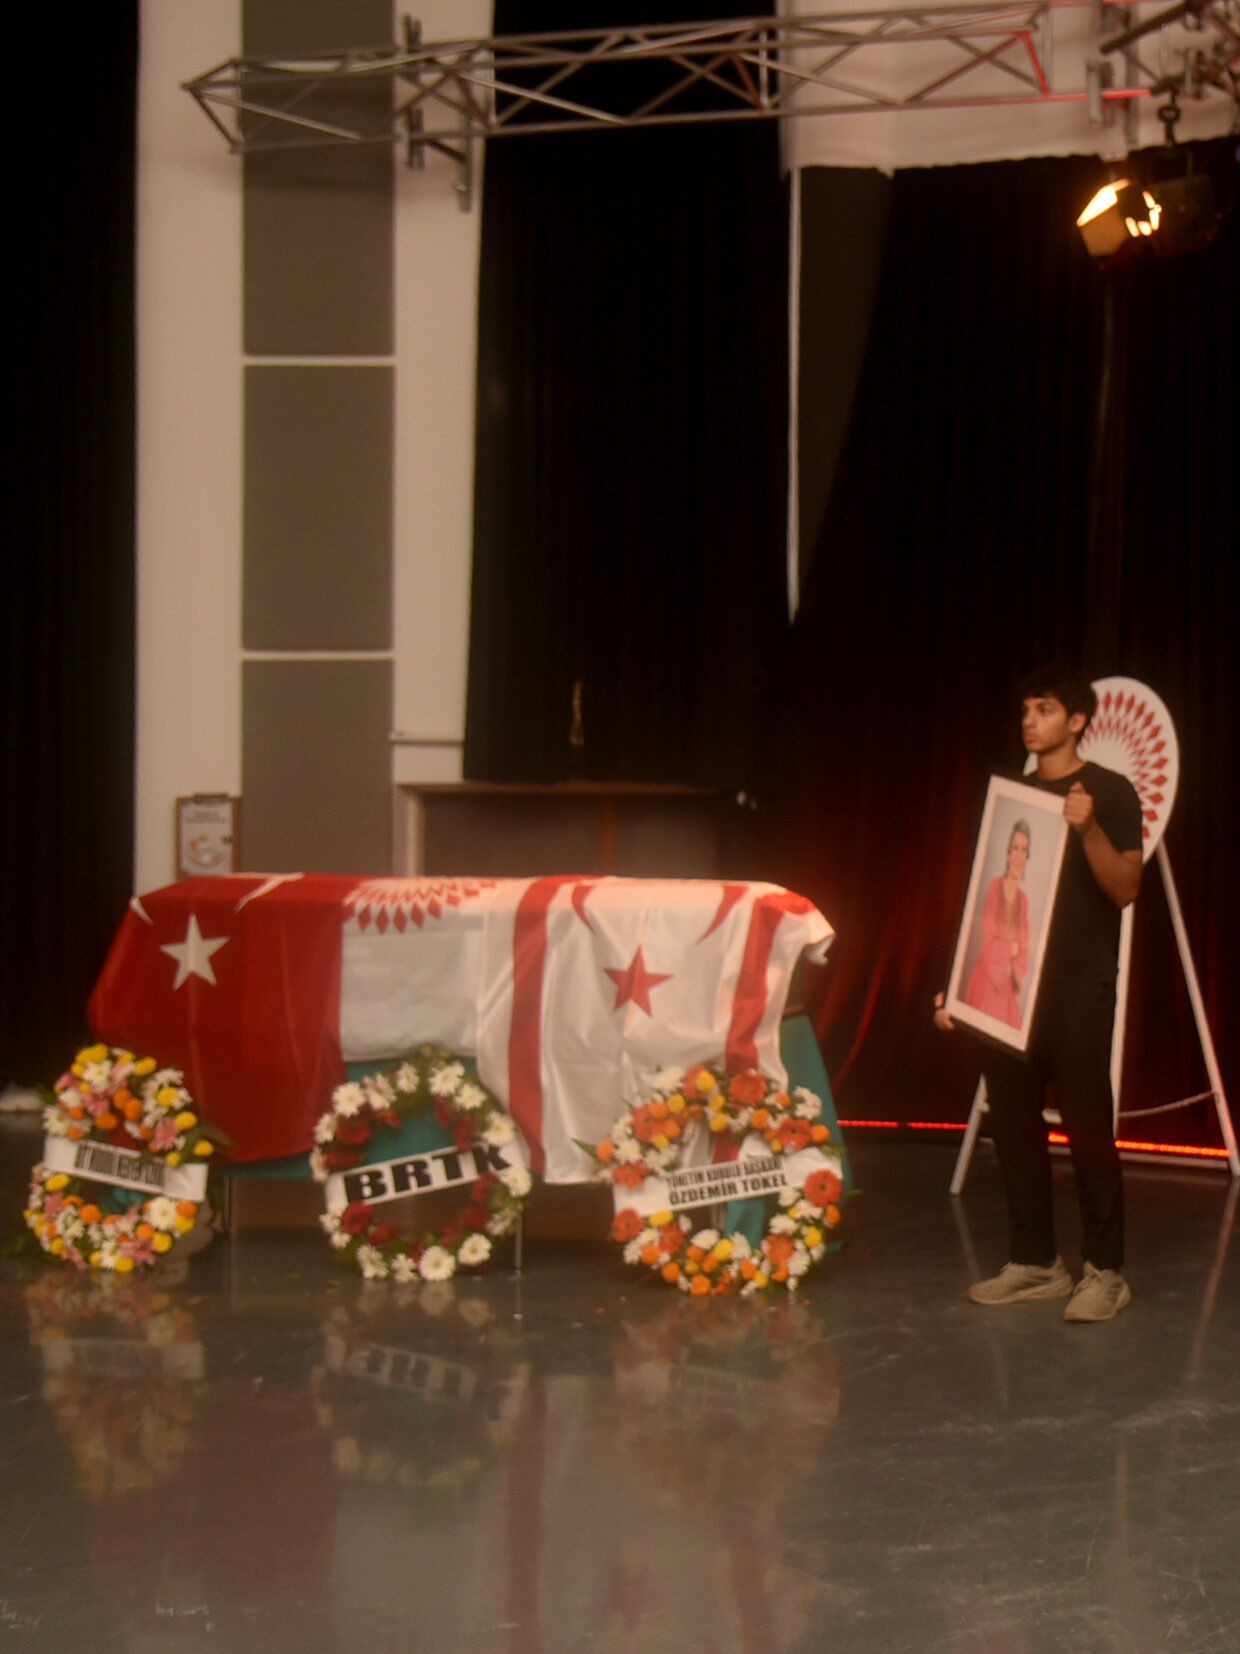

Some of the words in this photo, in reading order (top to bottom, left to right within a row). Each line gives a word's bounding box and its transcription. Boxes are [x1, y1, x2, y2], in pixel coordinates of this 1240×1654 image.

[343, 1145, 511, 1203] BRTK
[669, 1179, 738, 1206] ÖZDEMİR
[741, 1173, 787, 1192] TOKEL
